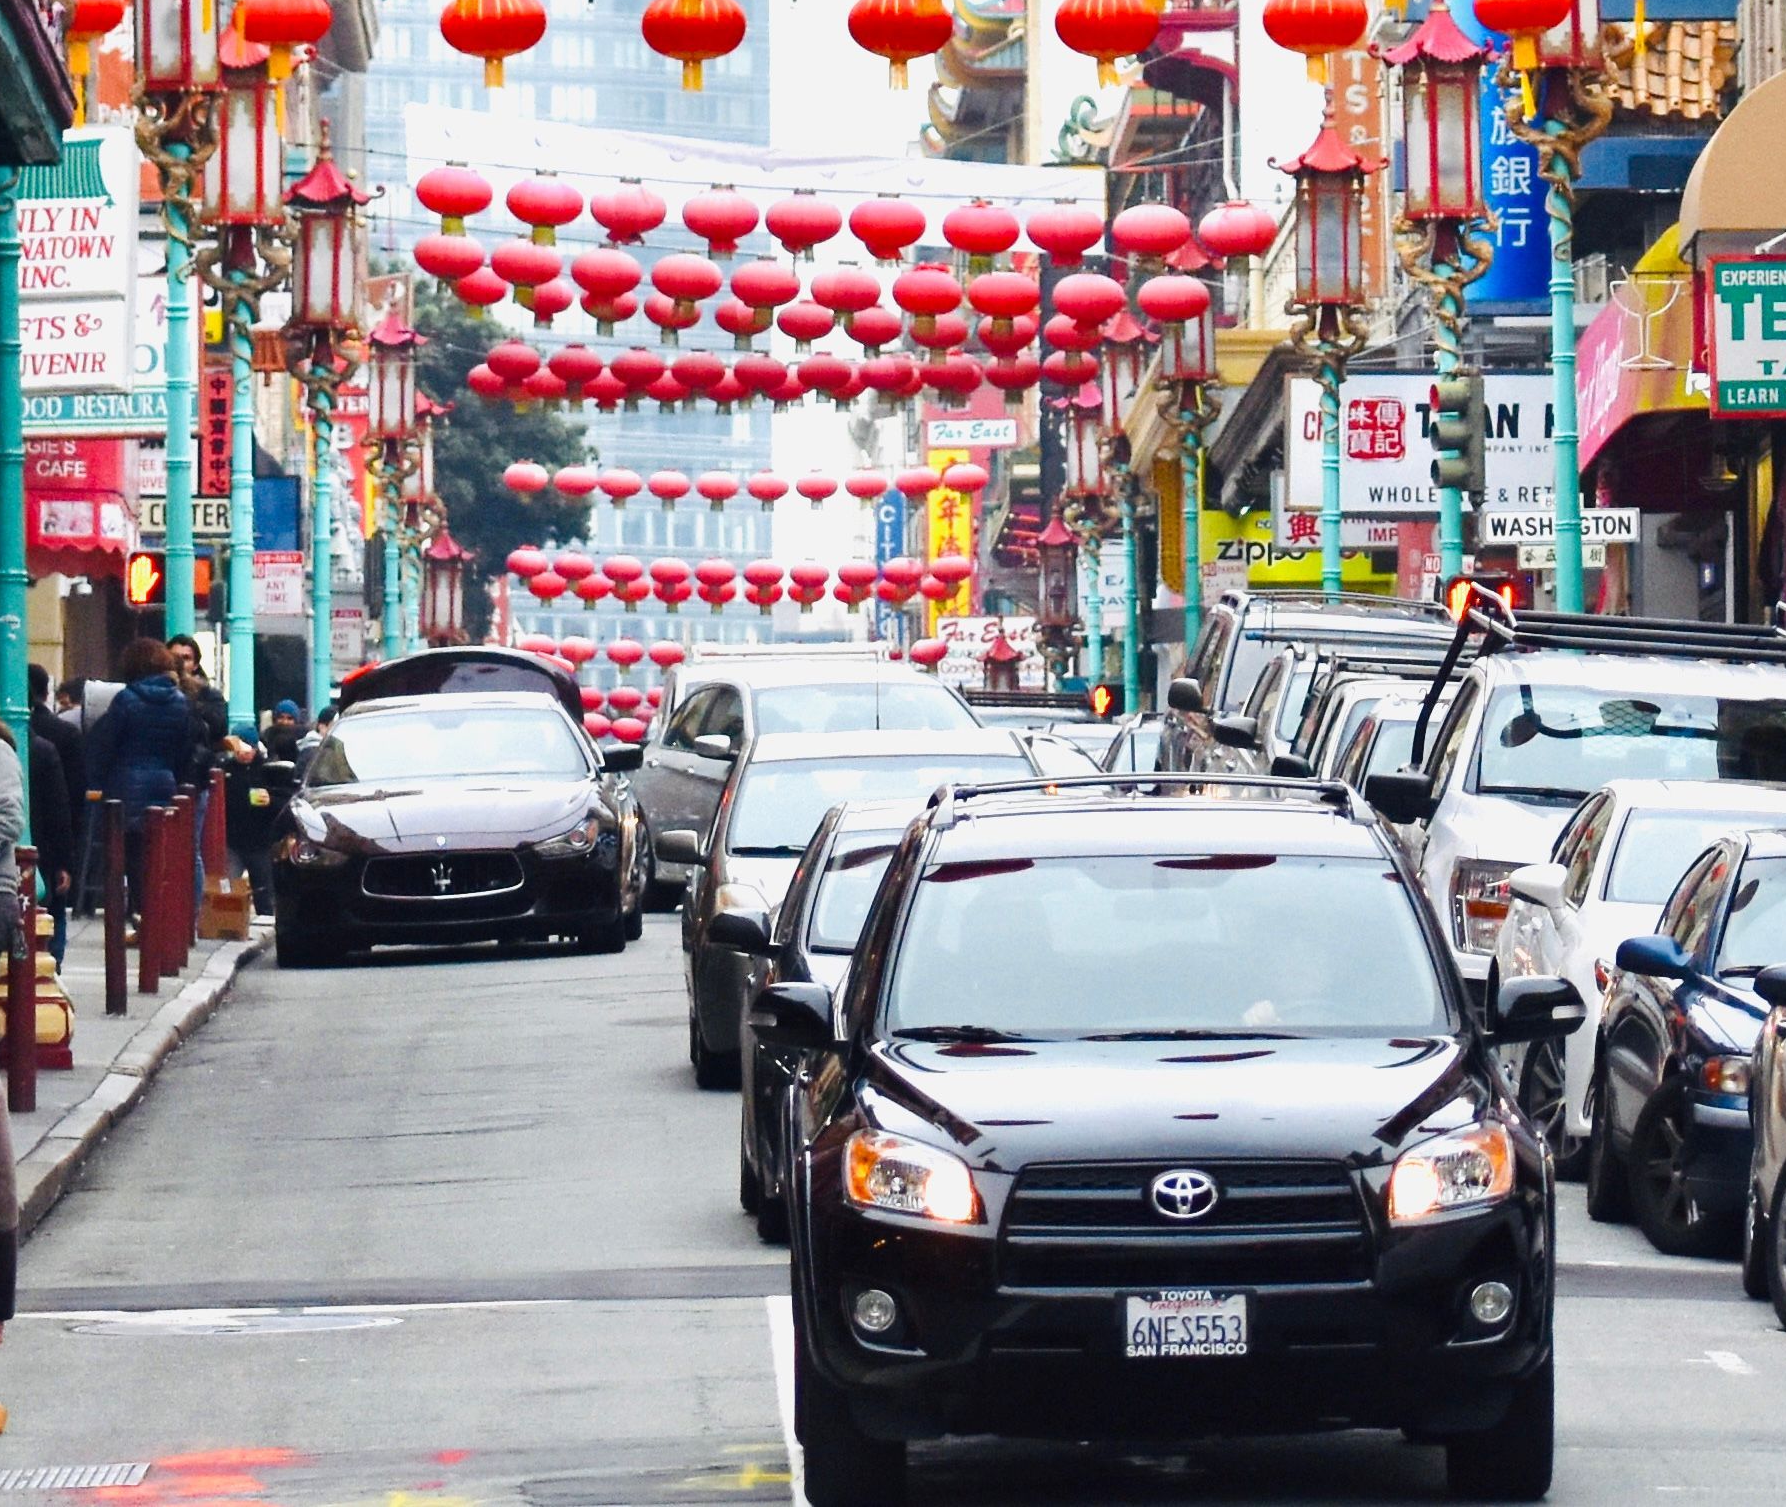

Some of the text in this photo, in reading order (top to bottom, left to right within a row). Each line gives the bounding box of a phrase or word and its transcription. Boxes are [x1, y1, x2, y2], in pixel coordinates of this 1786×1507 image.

[1490, 104, 1532, 248] 旗銀行
[69, 206, 102, 232] IN
[21, 265, 72, 289] INC.
[74, 313, 103, 338] &
[73, 393, 198, 418] RESTAURA
[1727, 387, 1779, 405] LEARN
[933, 422, 1011, 441] Far East
[1485, 444, 1524, 453] MPANY
[36, 460, 87, 478] CAFE
[1497, 487, 1509, 503] &
[151, 503, 230, 530] CTER
[1491, 515, 1632, 537] WASHGTON
[941, 621, 975, 643] Far
[1159, 1290, 1213, 1301] TOYOTA
[1132, 1314, 1242, 1345] 6NES553
[1126, 1342, 1247, 1357] SAN FRANCISCO
